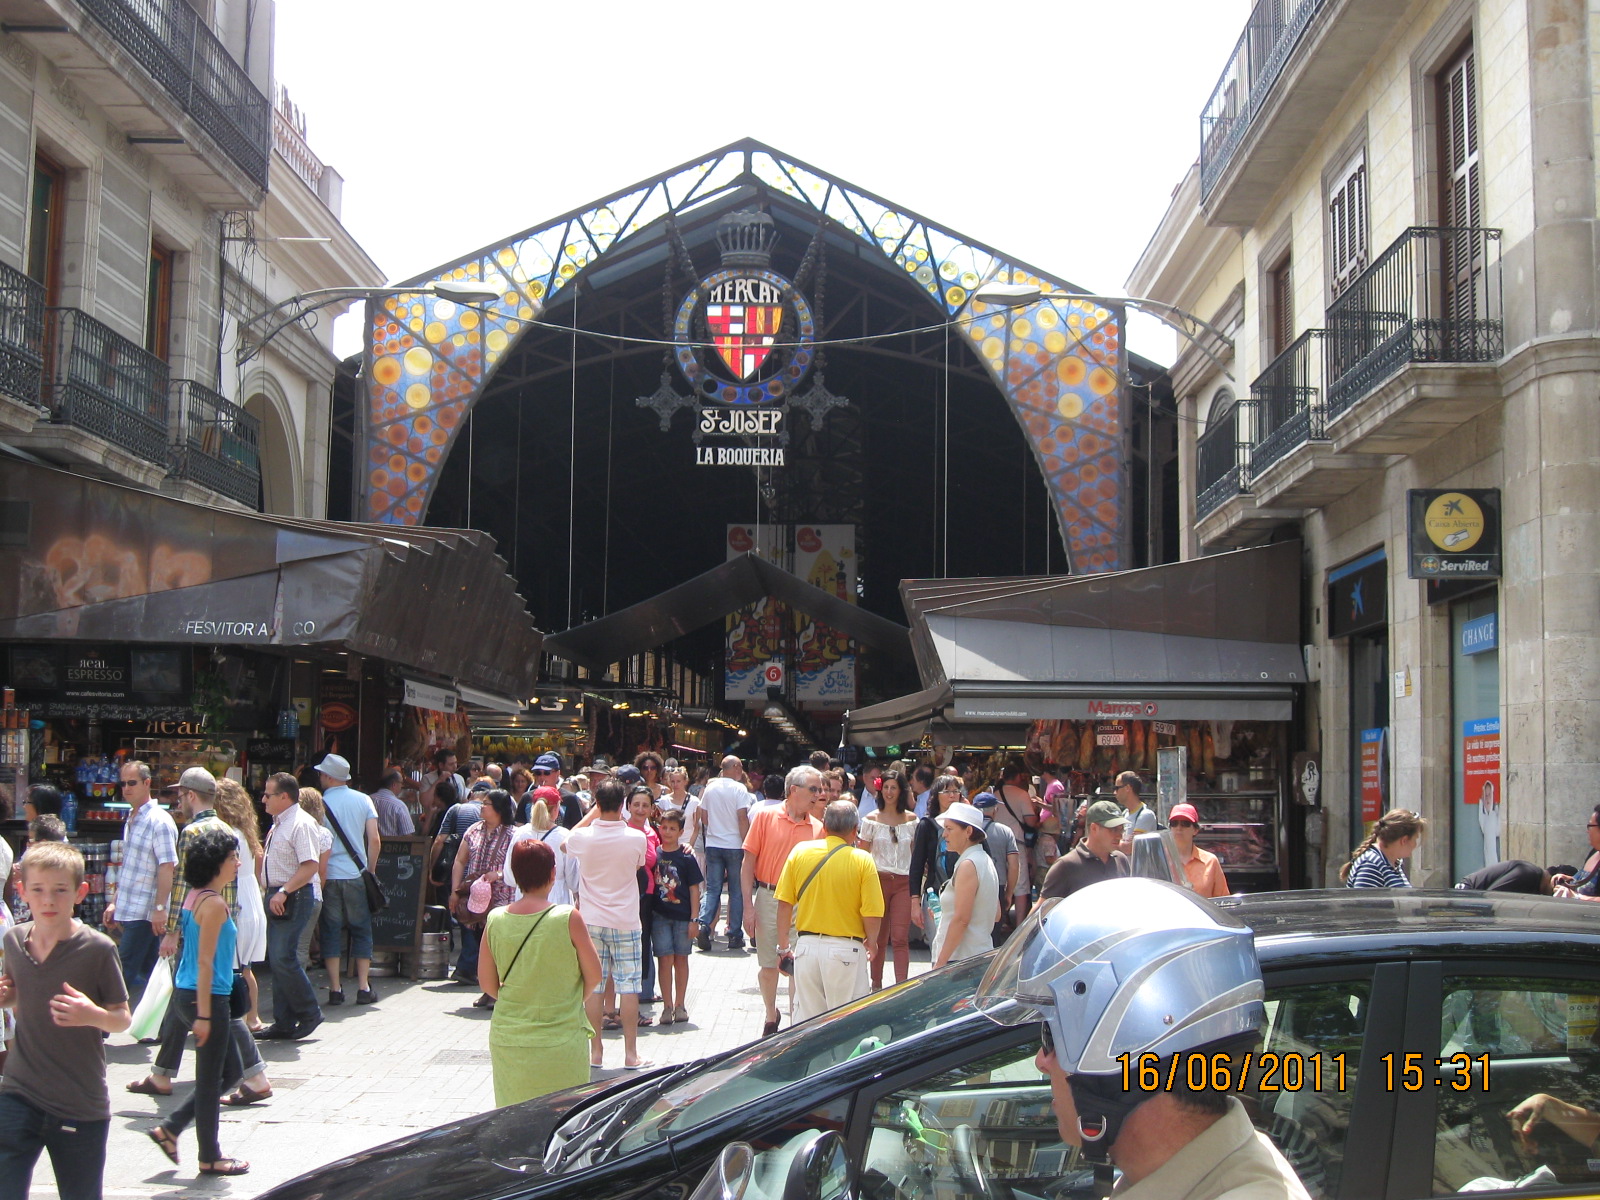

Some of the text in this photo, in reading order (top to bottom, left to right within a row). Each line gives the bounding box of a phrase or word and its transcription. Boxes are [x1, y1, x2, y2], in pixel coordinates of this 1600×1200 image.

[710, 278, 781, 303] MERCAT
[719, 410, 782, 433] JOSEP
[696, 447, 785, 466] LA BOQUERIA
[1428, 519, 1480, 528] Caixa Abierta
[1441, 560, 1489, 571] ServiRed
[1462, 622, 1494, 646] CHANGE
[67, 669, 122, 680] ESPRESSO
[770, 668, 777, 679] 6
[1088, 701, 1142, 714] Marcos
